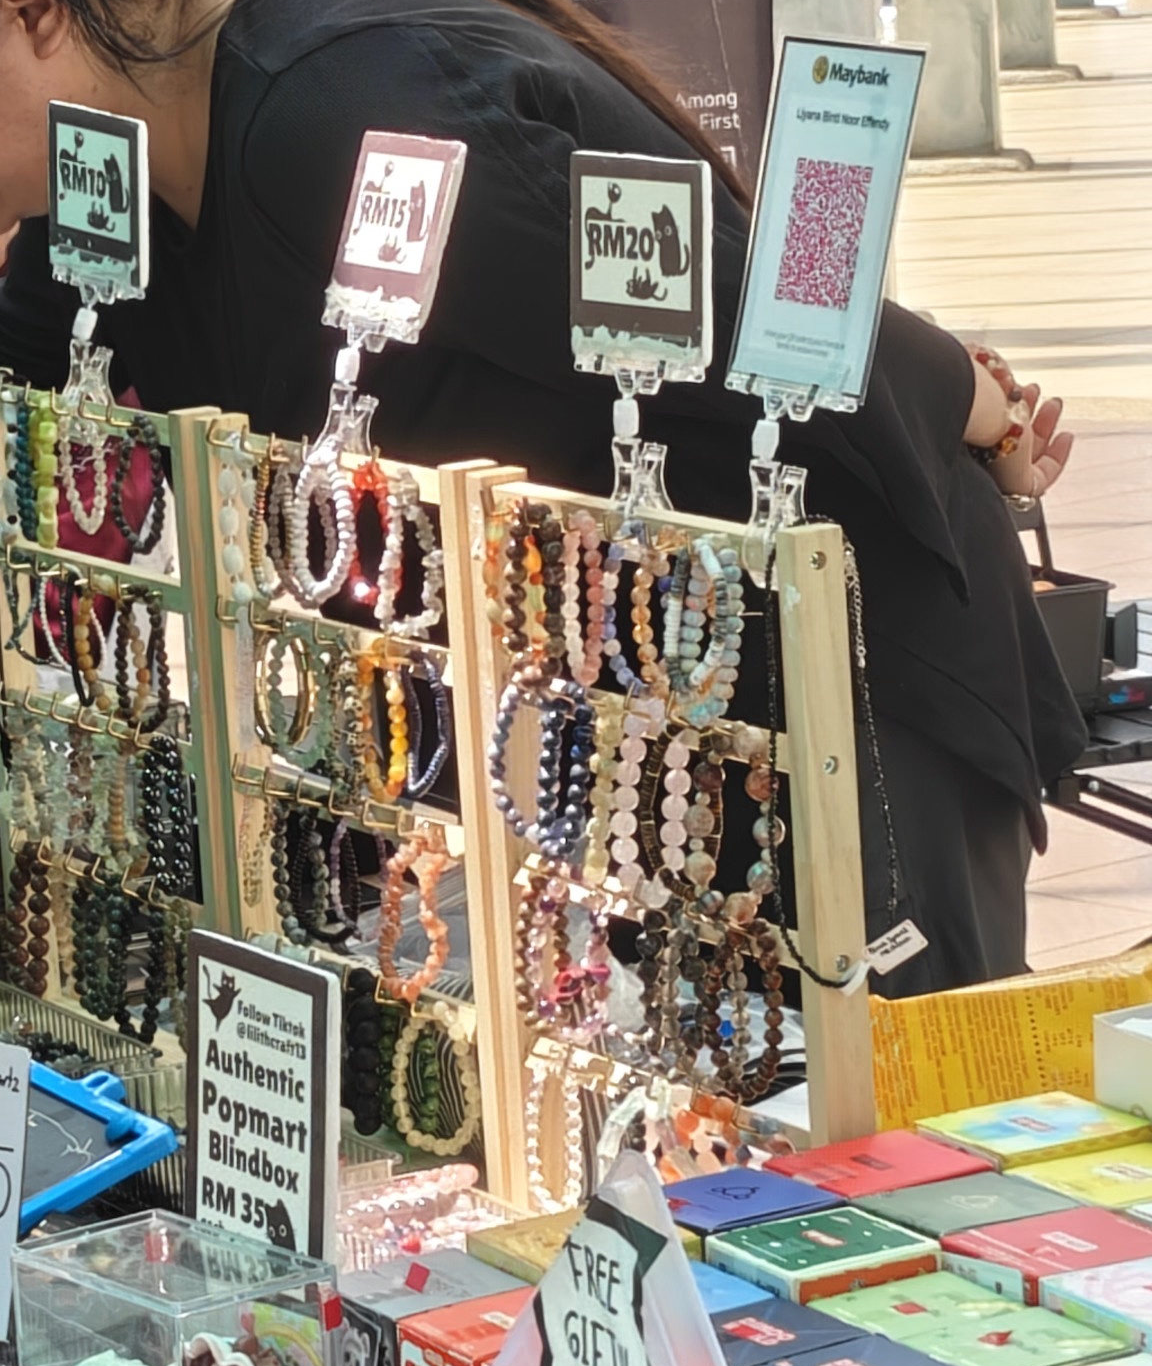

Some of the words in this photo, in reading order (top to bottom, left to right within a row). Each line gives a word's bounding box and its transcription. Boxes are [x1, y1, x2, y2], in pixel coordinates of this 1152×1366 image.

[829, 62, 891, 88] Maybank
[676, 92, 737, 110] Among
[699, 112, 741, 131] First
[59, 161, 108, 199] RM10
[359, 194, 408, 229] RM15
[587, 222, 655, 262] RM20
[237, 999, 271, 1027] Follow
[205, 1038, 306, 1104] Authentic
[201, 1078, 308, 1154] Popmart
[208, 1129, 300, 1195] Blindbox
[201, 1175, 236, 1219] RM
[240, 1192, 265, 1230] 35
[562, 1233, 622, 1316] FREE
